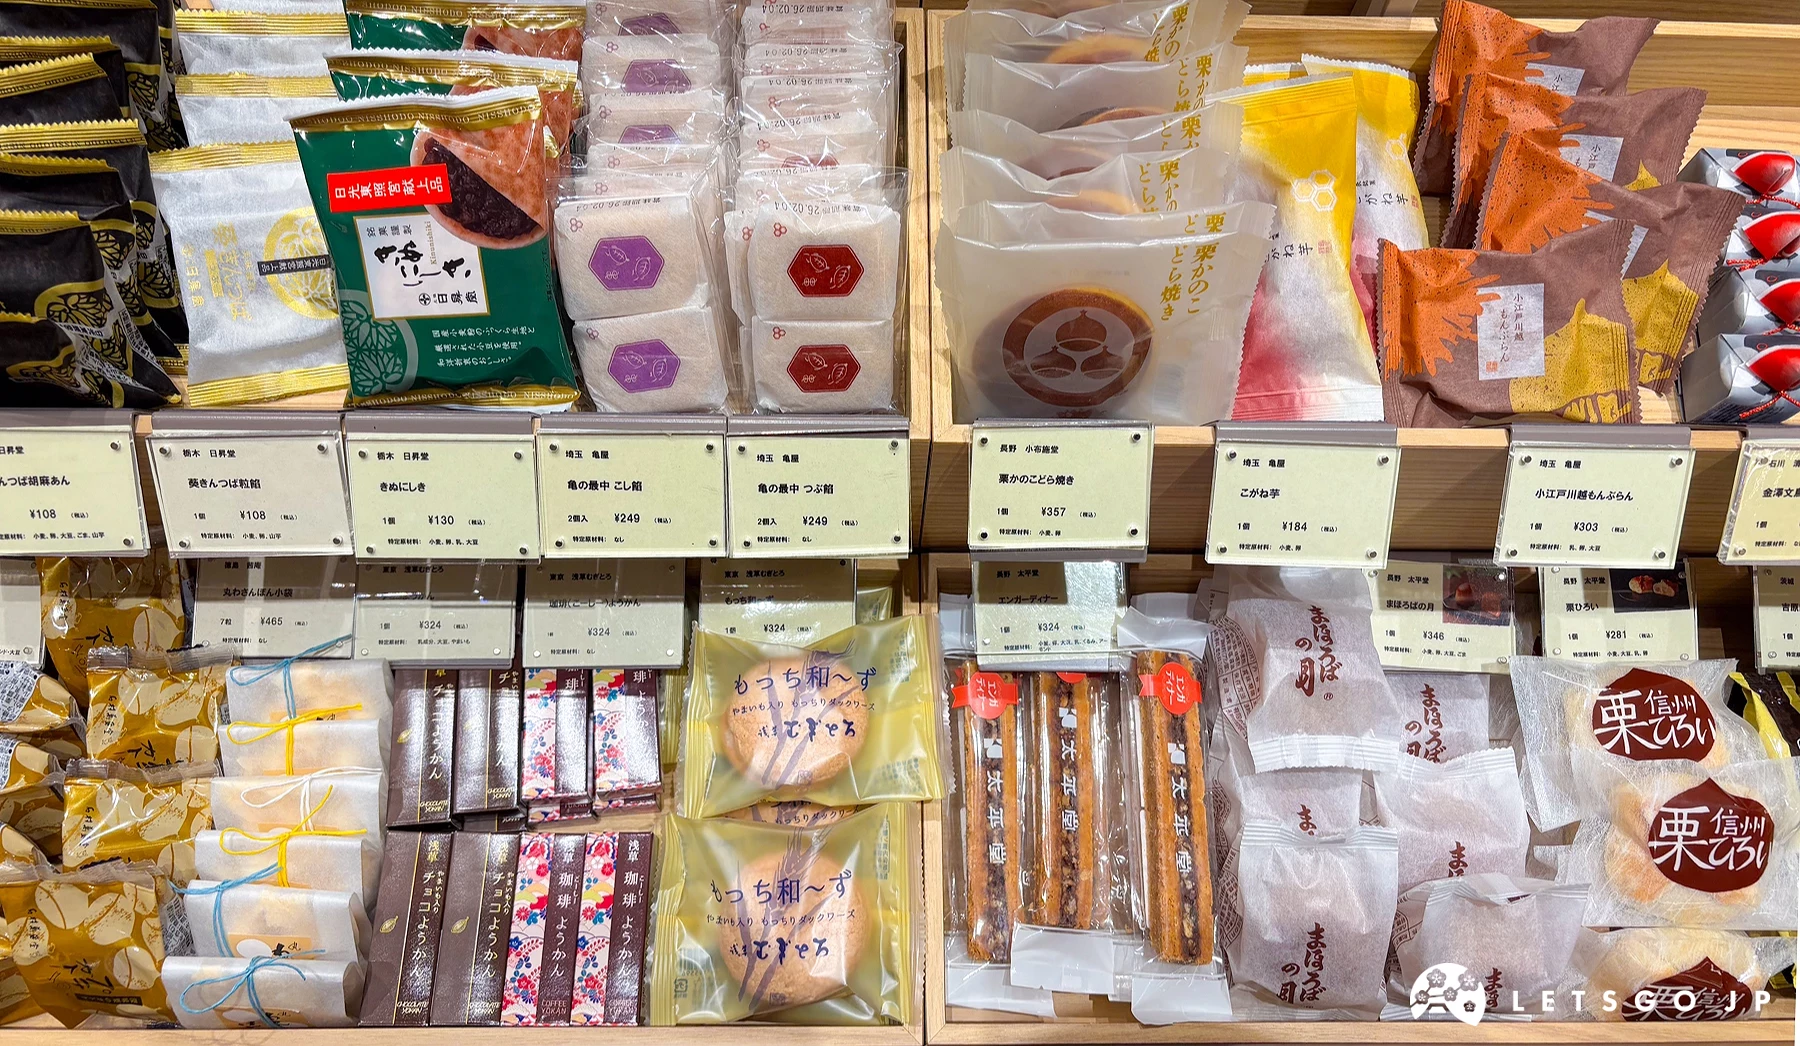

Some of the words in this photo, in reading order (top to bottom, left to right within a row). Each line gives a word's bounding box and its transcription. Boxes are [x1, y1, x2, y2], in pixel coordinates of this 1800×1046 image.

[358, 113, 414, 123] NISSHODO
[418, 112, 470, 123] NISSHODO
[478, 105, 536, 121] NISSHODO
[335, 176, 444, 200] 日光東照宮献上品
[774, 201, 819, 215] 26.02.04
[366, 224, 411, 238] 銘菓謹製
[424, 221, 439, 265] Kinunishiki
[374, 240, 472, 287] きぬにしき
[1160, 245, 1182, 321] どら焼き
[1187, 242, 1217, 315] 栗かのこ
[1513, 293, 1525, 342] 小江戸川越
[432, 326, 536, 338] 国産小麦粉のふっくら生地と
[1499, 310, 1510, 363] もんぶらん
[434, 341, 523, 353] 厳選された小豆を使用。
[437, 356, 512, 368] 和洋折衷のおいしさ。
[183, 449, 200, 457] 栃木
[566, 450, 583, 458] 埼玉
[592, 451, 609, 459] 亀屋
[1000, 444, 1016, 452] 長野
[1025, 445, 1058, 453] 小布施堂
[377, 452, 394, 460] 栃木
[404, 452, 429, 460] 日昇堂
[757, 454, 773, 462] 埼玉
[783, 454, 799, 462] 亀屋
[1243, 459, 1259, 467] 埼玉
[1269, 459, 1285, 467] 亀屋
[1540, 460, 1556, 468] 埼玉
[1565, 460, 1581, 468] 亀屋
[1766, 458, 1785, 468] 石川
[188, 478, 261, 489] 葵きんつば粒餡
[568, 480, 609, 491] 亀の最中
[614, 481, 642, 491] こし餡
[999, 474, 1074, 485] 栗かのこどら焼き
[380, 482, 425, 492] きぬにしき
[758, 483, 799, 494] 亀の最中
[804, 484, 833, 494] つぶ餡
[1241, 488, 1280, 499] こがね芋
[1536, 489, 1633, 501] 小江戸川越もんぶらん
[30, 509, 56, 519] ¥108
[240, 511, 266, 520] ¥108
[1042, 507, 1066, 516] ¥357
[428, 516, 454, 525] ¥130
[615, 513, 639, 523] ¥249
[803, 516, 827, 525] ¥249
[1283, 522, 1307, 531] ¥184
[1574, 522, 1598, 531] ¥303
[404, 566, 444, 574] 浅草むぎとろ
[1387, 574, 1401, 582] 長野
[1408, 576, 1429, 584] 太平堂
[223, 588, 292, 597] 丸わさんぼん小袋
[998, 595, 1058, 604] エンガーディナー
[1386, 600, 1434, 611] まほろばの月
[1566, 603, 1599, 612] 栗ひろい
[261, 617, 282, 625] ¥465
[420, 621, 441, 629] ¥324
[1038, 623, 1059, 631] ¥324
[588, 628, 610, 636] ¥324
[764, 624, 785, 632] ¥324
[1423, 631, 1444, 640] ¥346
[1606, 630, 1626, 639] ¥281
[1308, 605, 1342, 682] まほろば
[1295, 637, 1315, 697] の月
[734, 665, 877, 696] もっち和〜ず
[1165, 670, 1175, 705] ディナー
[1175, 675, 1186, 703] エンガ
[975, 677, 987, 712] ディナー
[987, 681, 999, 708] エンガ
[732, 700, 784, 716] やまいも入り
[791, 698, 875, 711] もっちりダックワーズ
[1644, 689, 1697, 715] 信州
[1594, 690, 1717, 755] 栗ひろい
[1061, 740, 1079, 831] 太平堂
[986, 771, 1006, 864] 太平堂
[1710, 807, 1766, 836] 信州
[1171, 777, 1190, 873] 太平堂
[1648, 806, 1773, 871] 栗ひろい
[427, 841, 439, 862] 浅草
[627, 841, 639, 862] 浅草
[432, 871, 444, 915] やまいも入り
[502, 871, 515, 915] やまいも入り
[637, 875, 645, 903] こーしー
[711, 869, 852, 905] もっち和〜ず
[706, 914, 753, 927] やまいも入り
[761, 908, 856, 926] もっちりダックワーズ
[411, 871, 436, 977] チョコようかん
[482, 871, 506, 977] チョコようかん
[551, 872, 573, 977] 珈琲ようかん
[617, 872, 638, 978] 珈琲ようかん
[1299, 922, 1327, 1002] まほろば
[541, 1007, 566, 1015] YOKAN
